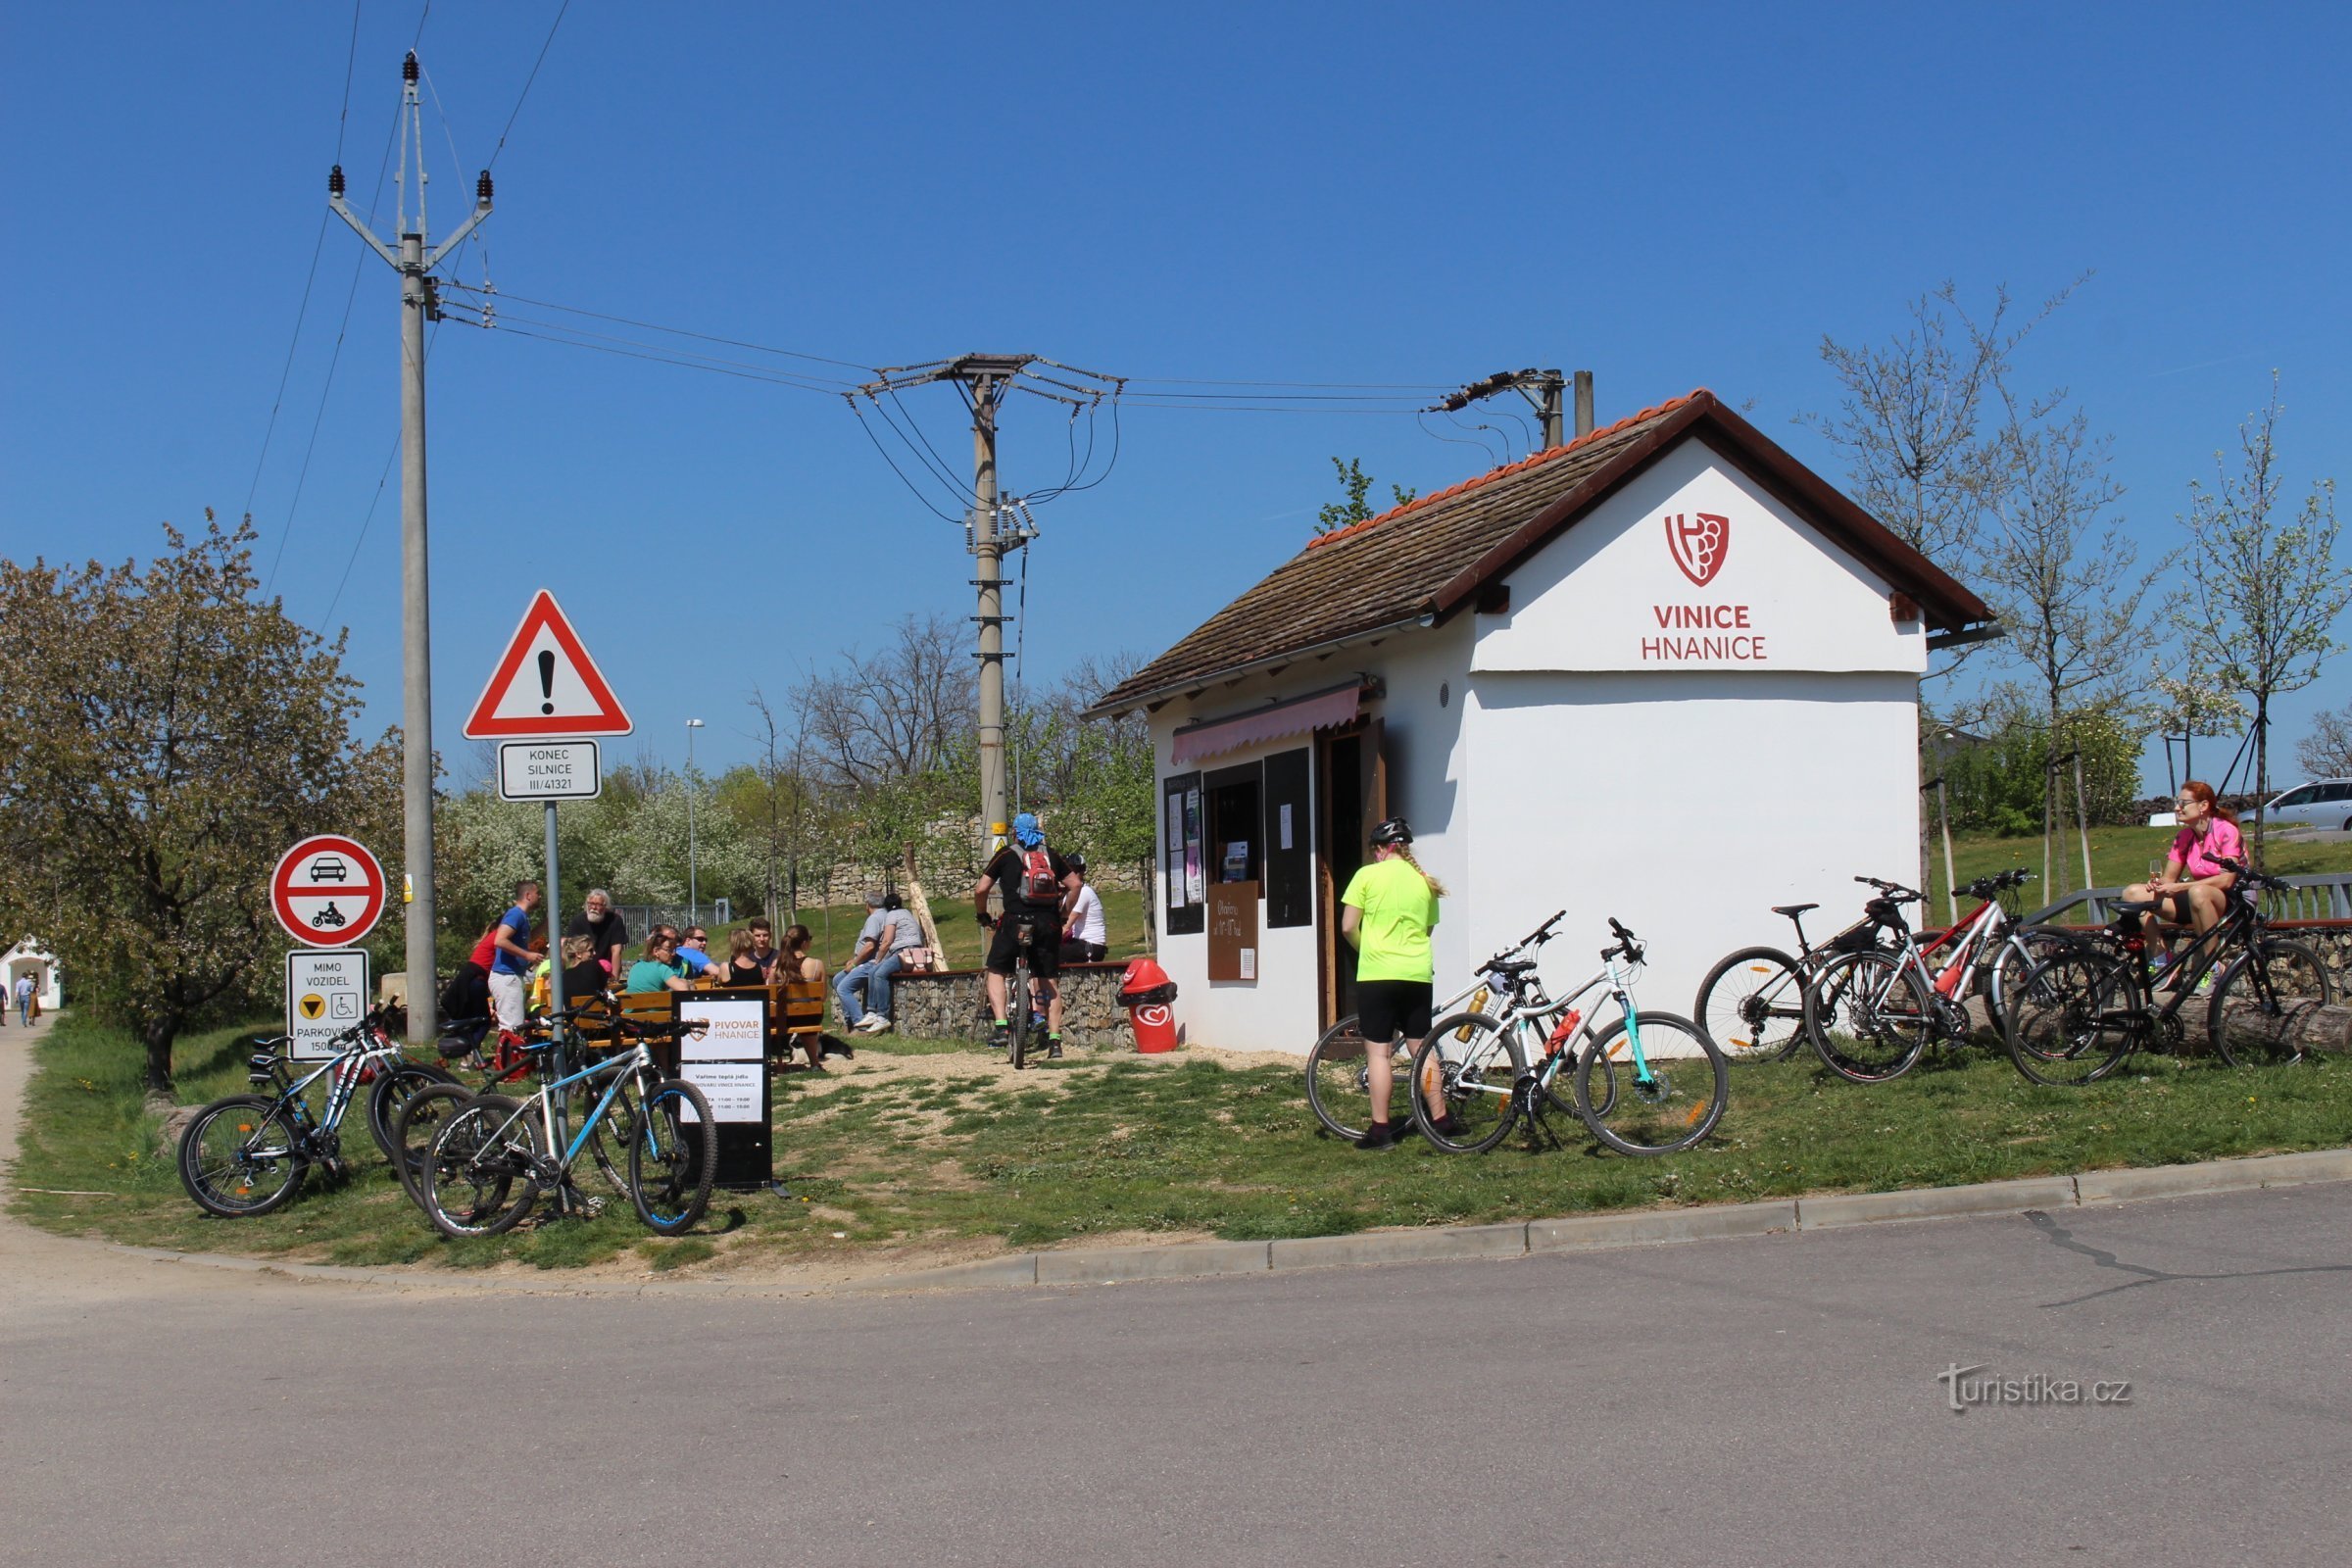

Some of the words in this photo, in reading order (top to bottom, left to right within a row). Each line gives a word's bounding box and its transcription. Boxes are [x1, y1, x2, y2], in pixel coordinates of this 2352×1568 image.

[1653, 605, 1750, 628] VINICE
[1642, 636, 1767, 660] HNANICE
[529, 750, 569, 760] KONEC
[528, 764, 572, 775] SILNICE
[529, 779, 571, 790] III/41321
[314, 962, 342, 972] MIMO
[306, 976, 350, 987] VOZIDEL
[714, 1020, 759, 1029] PIVOVAR
[297, 1025, 351, 1038] PARKOVIŠ
[714, 1030, 760, 1039] HNANICE
